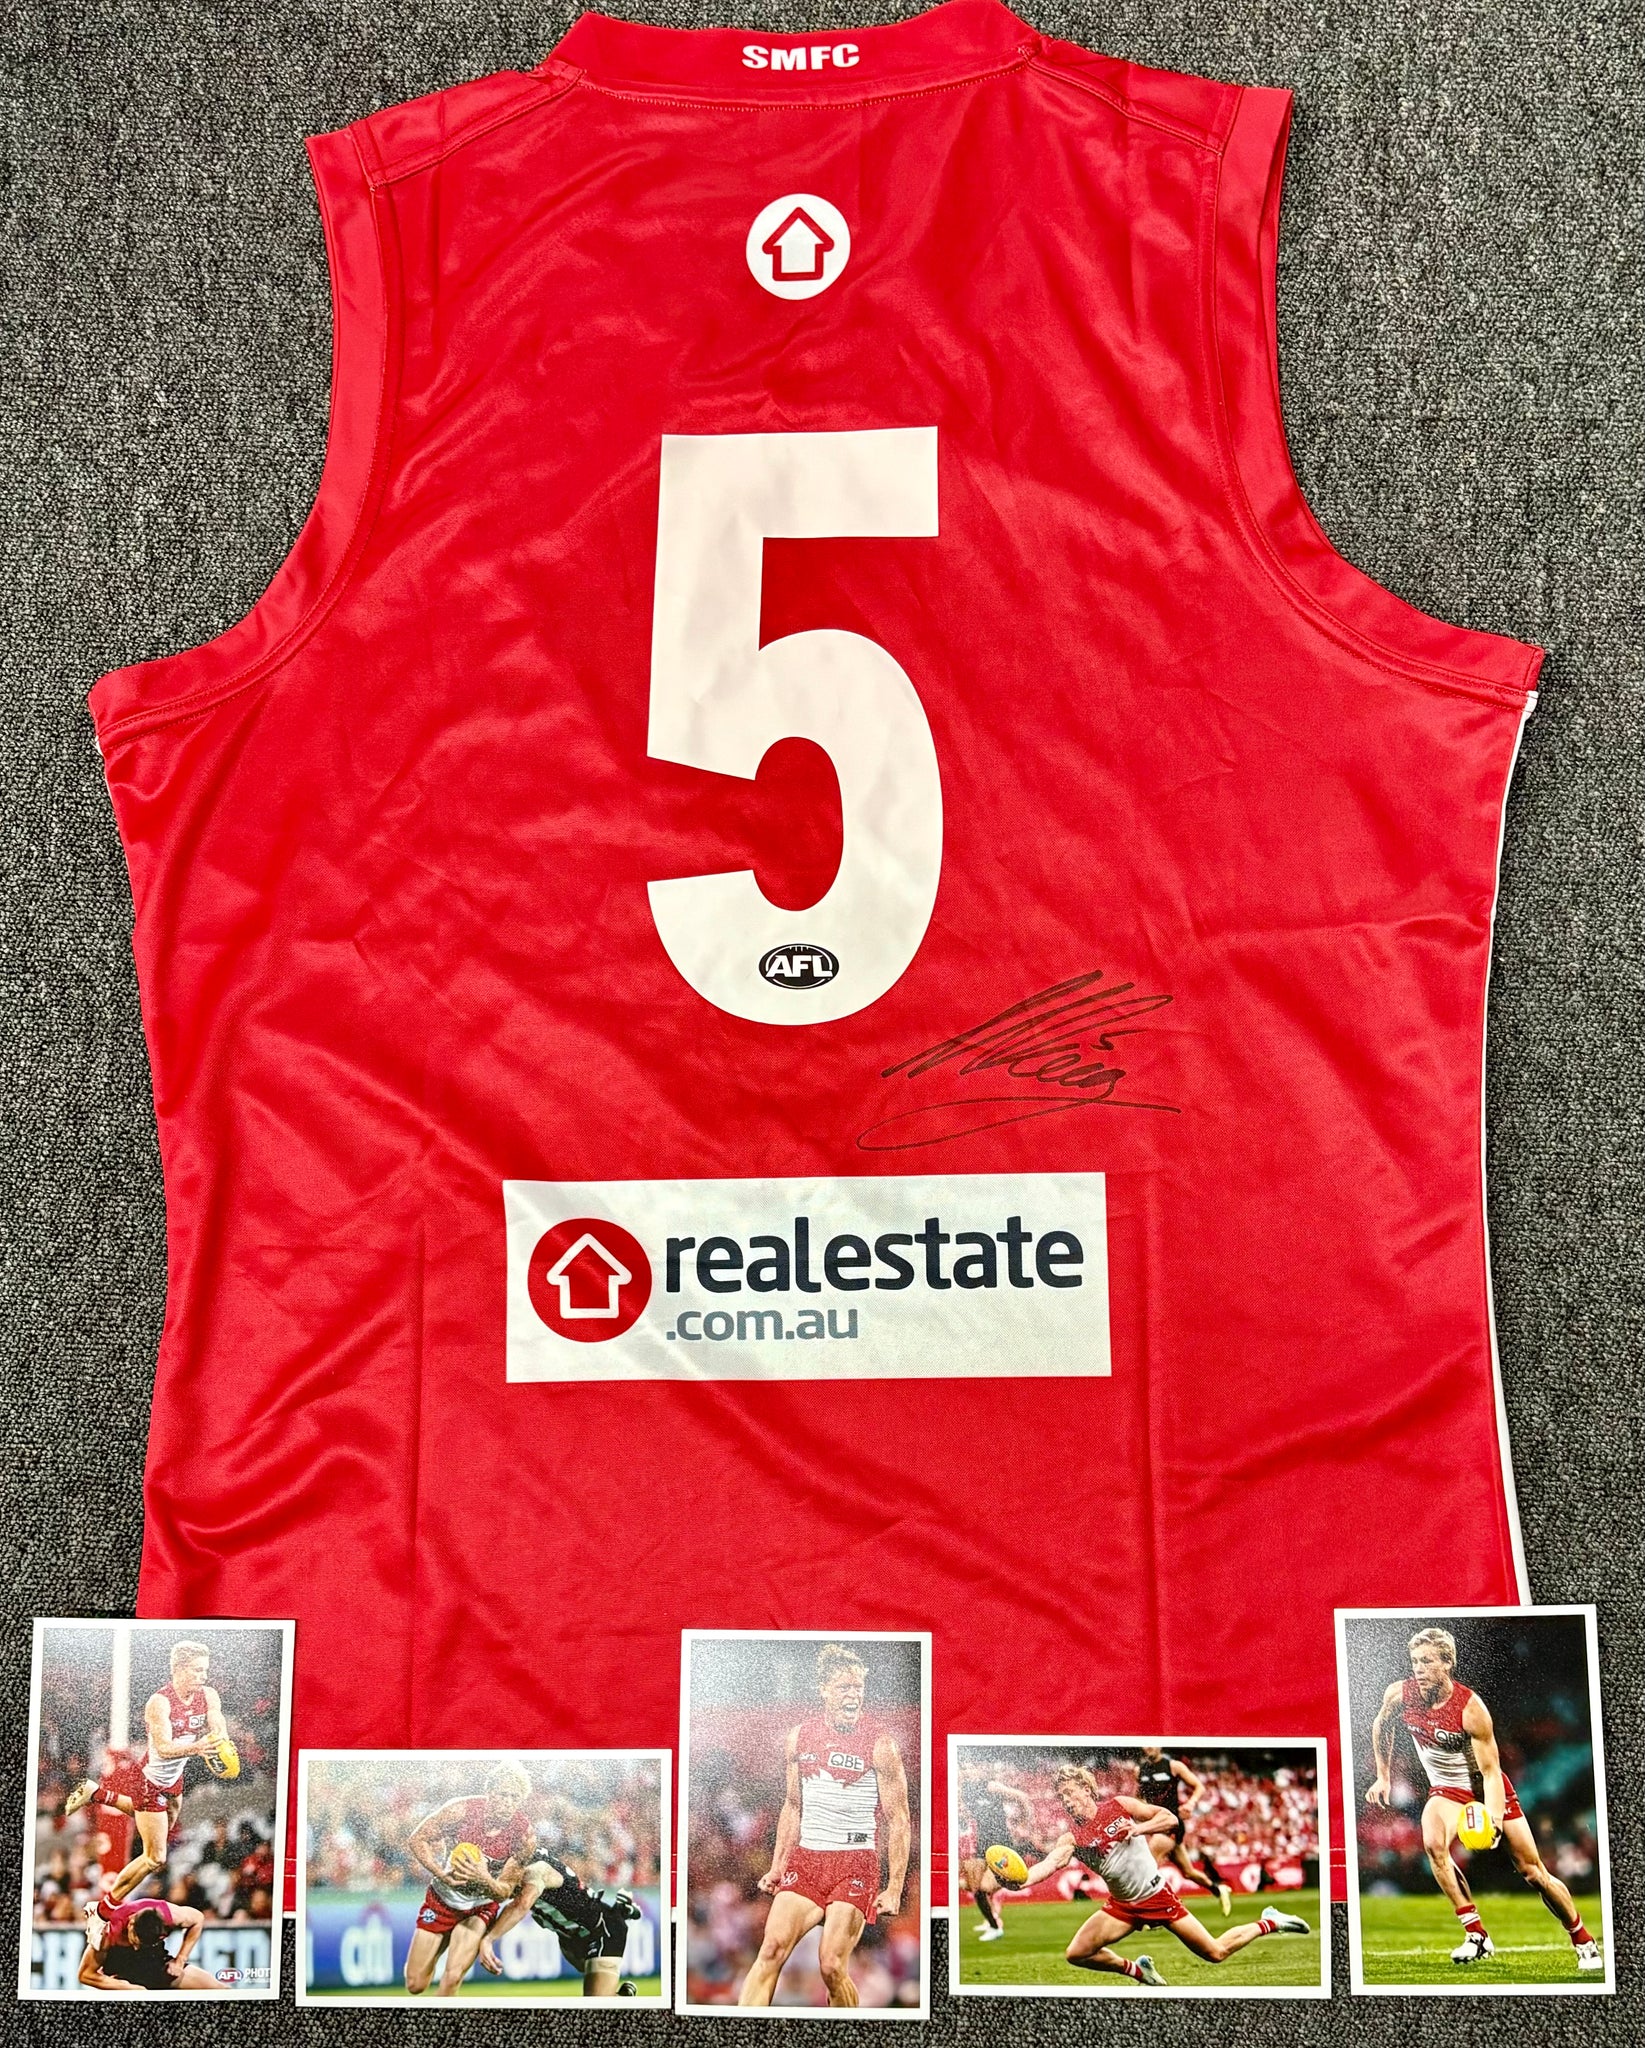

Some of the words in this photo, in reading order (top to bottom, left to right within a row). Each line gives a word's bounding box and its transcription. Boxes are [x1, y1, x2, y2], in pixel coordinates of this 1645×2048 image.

[742, 43, 860, 71] SMFC
[647, 426, 943, 1025] 5
[765, 955, 833, 977] AFL
[666, 1216, 1084, 1293] realestate
[666, 1309, 859, 1341] .com.au
[831, 1753, 863, 1770] QBE
[218, 1971, 242, 1981] AFL
